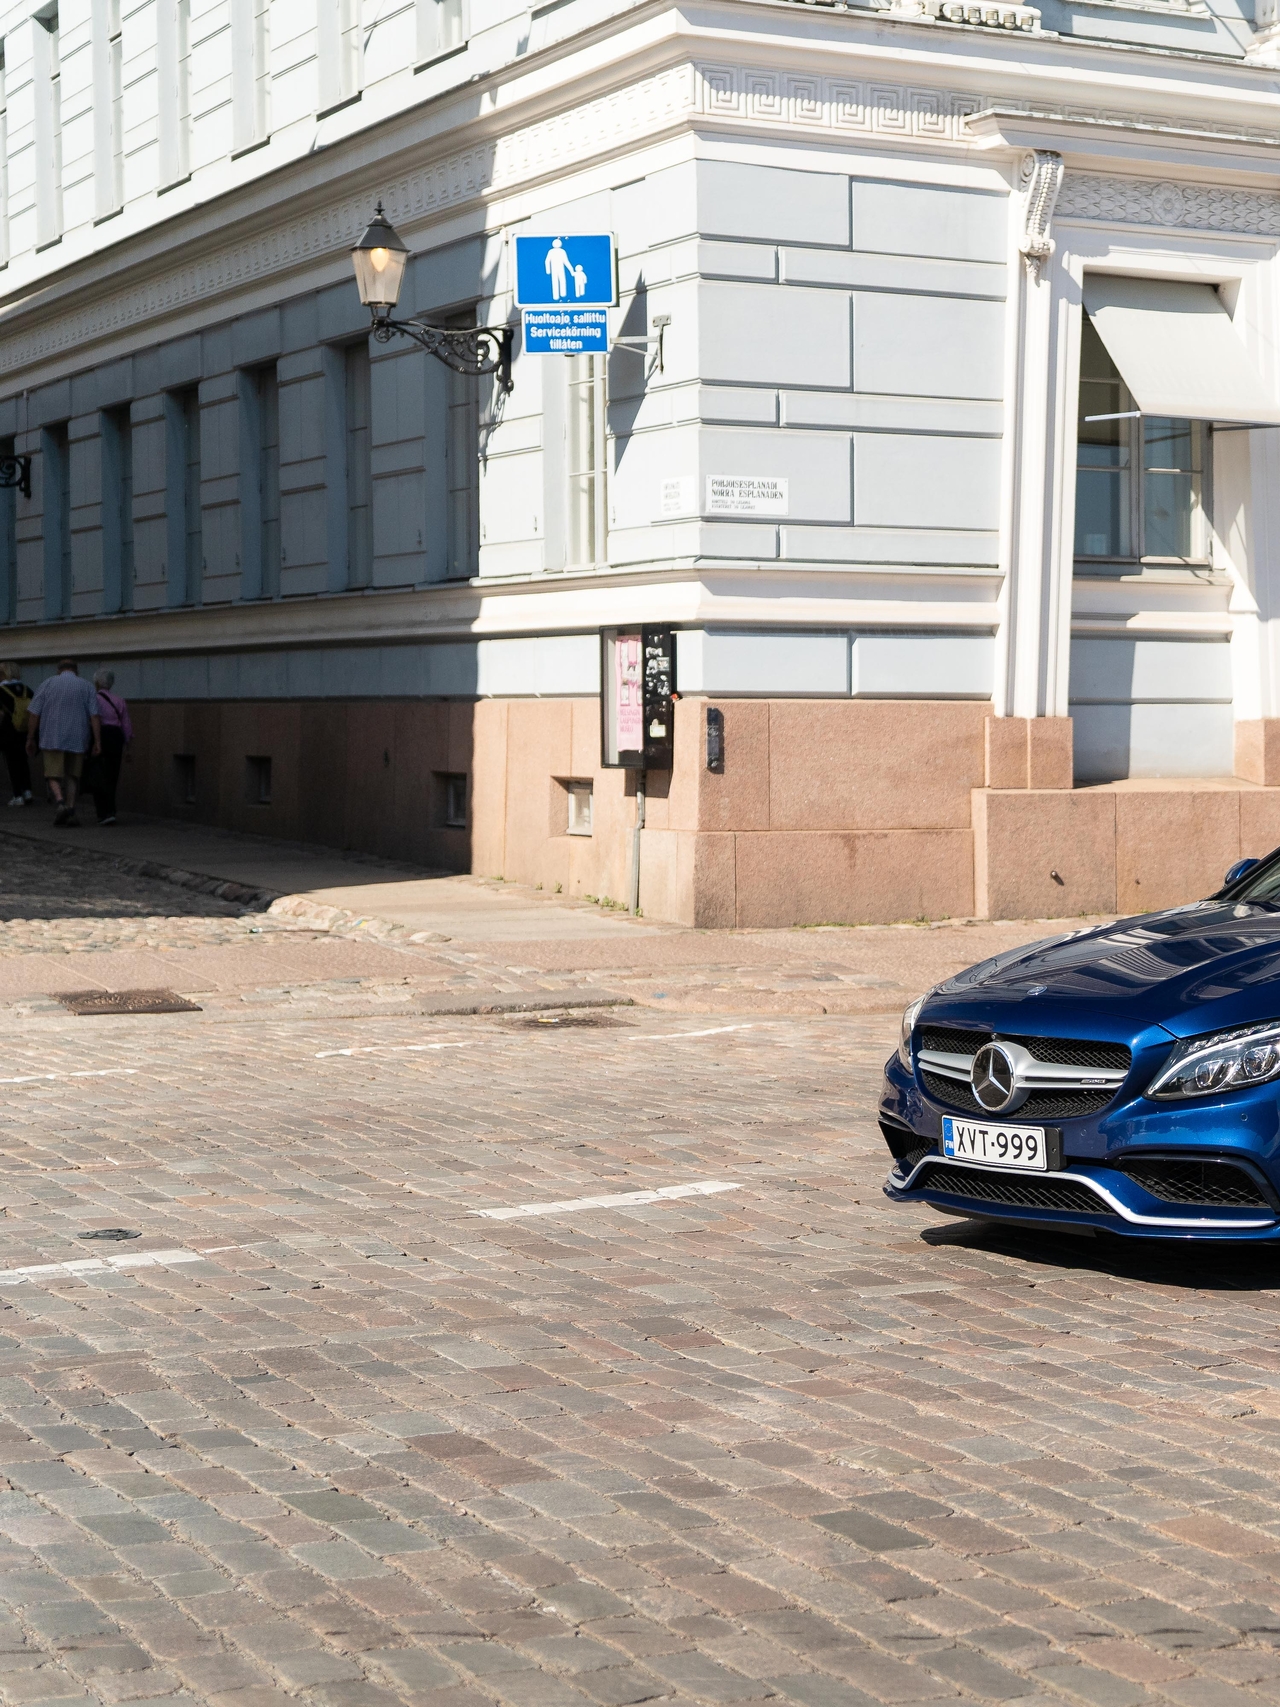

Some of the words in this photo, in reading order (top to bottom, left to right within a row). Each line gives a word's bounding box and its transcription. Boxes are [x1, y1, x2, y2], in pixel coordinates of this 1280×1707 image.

[525, 313, 570, 325] Huoltoajo
[573, 312, 606, 323] sallittu
[530, 326, 601, 338] Servicekörning
[549, 339, 583, 349] tillåten
[711, 479, 778, 490] POHJOISESPLANADI
[711, 489, 735, 498] NORRA
[738, 490, 784, 500] ESPLANADEN
[956, 1126, 1038, 1161] XVT-999
